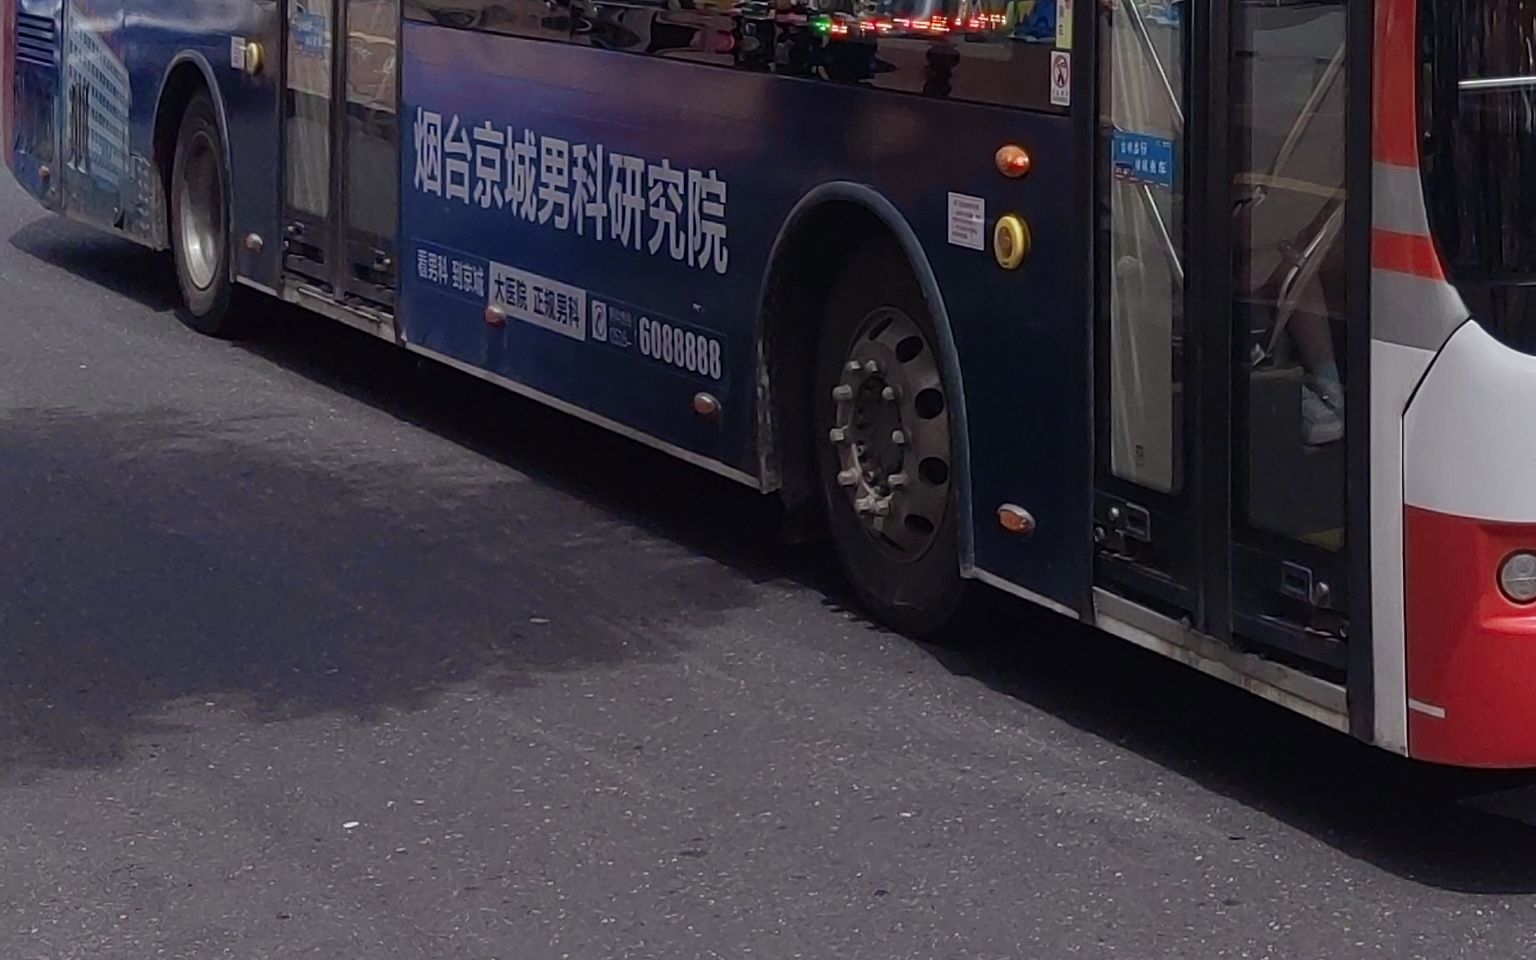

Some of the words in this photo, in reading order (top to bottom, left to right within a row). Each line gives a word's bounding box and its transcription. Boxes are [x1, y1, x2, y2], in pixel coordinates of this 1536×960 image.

[414, 106, 728, 274] 烟台京城男科研究院
[639, 316, 721, 380] 6088888
